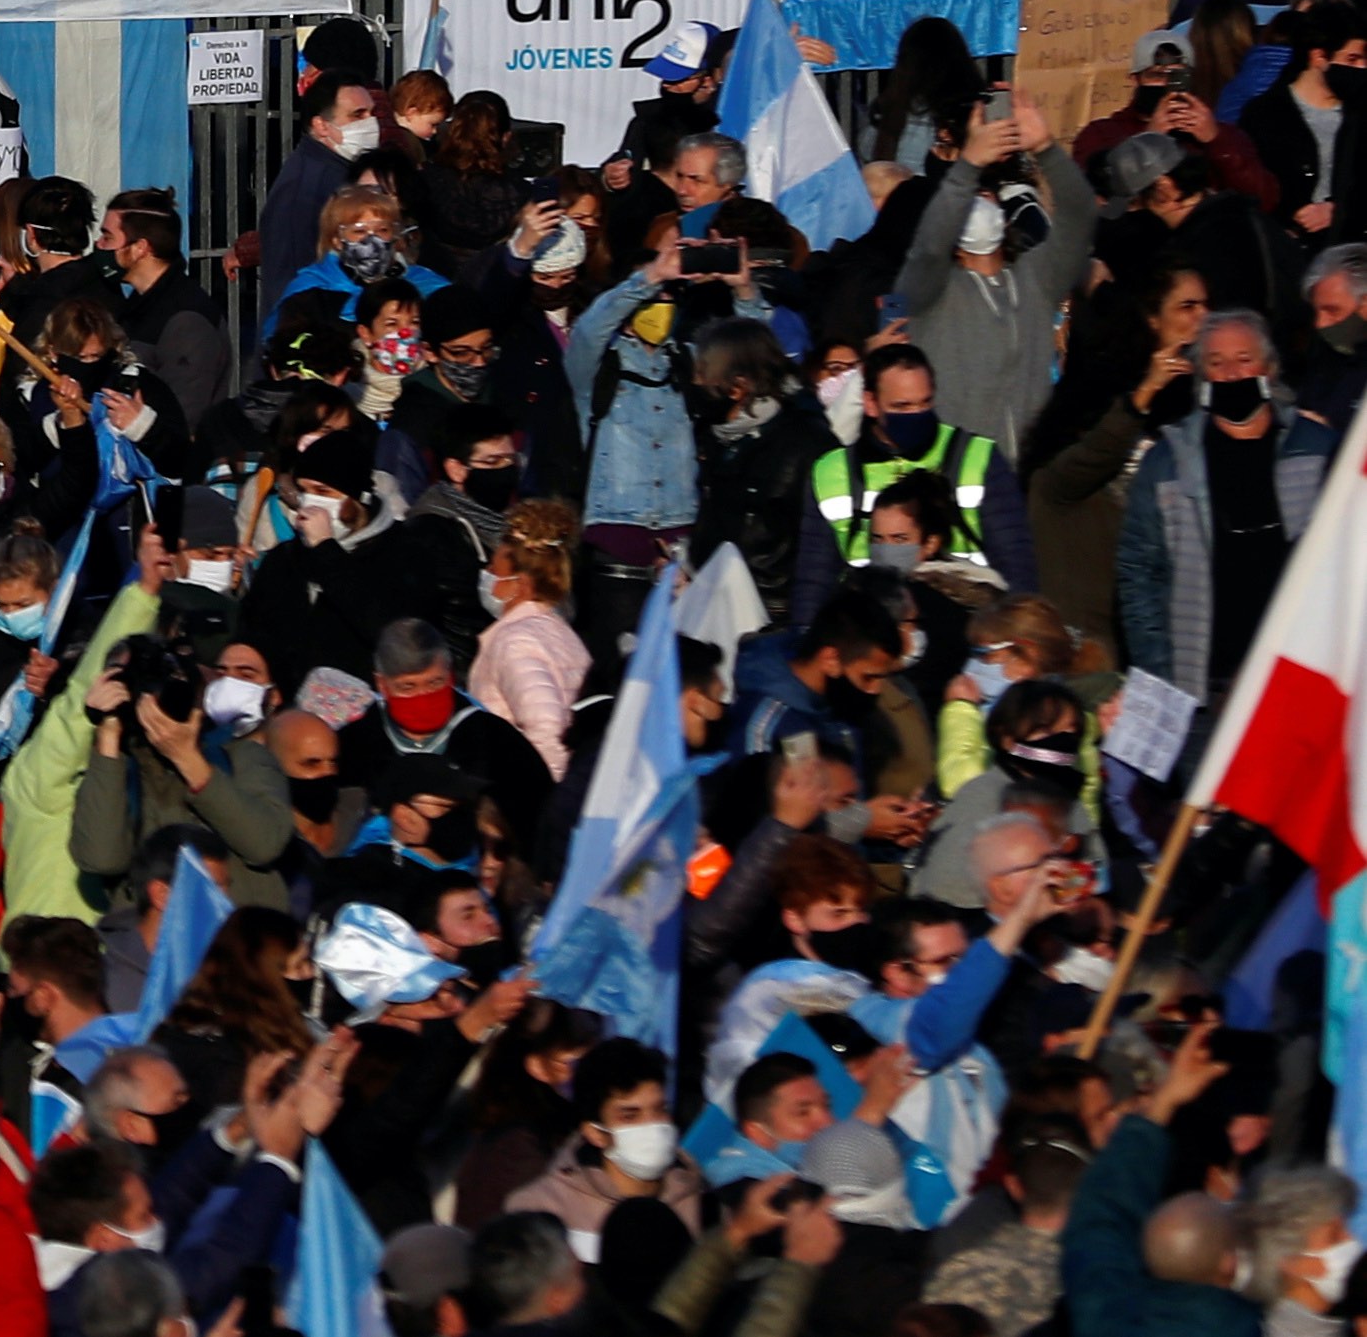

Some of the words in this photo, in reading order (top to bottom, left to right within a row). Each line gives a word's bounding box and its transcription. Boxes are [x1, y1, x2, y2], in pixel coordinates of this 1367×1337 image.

[214, 52, 240, 64] VIDA
[506, 44, 613, 71] JÓVENES
[199, 66, 254, 81] LIBERTAD
[193, 82, 259, 96] PROPIEDAD
